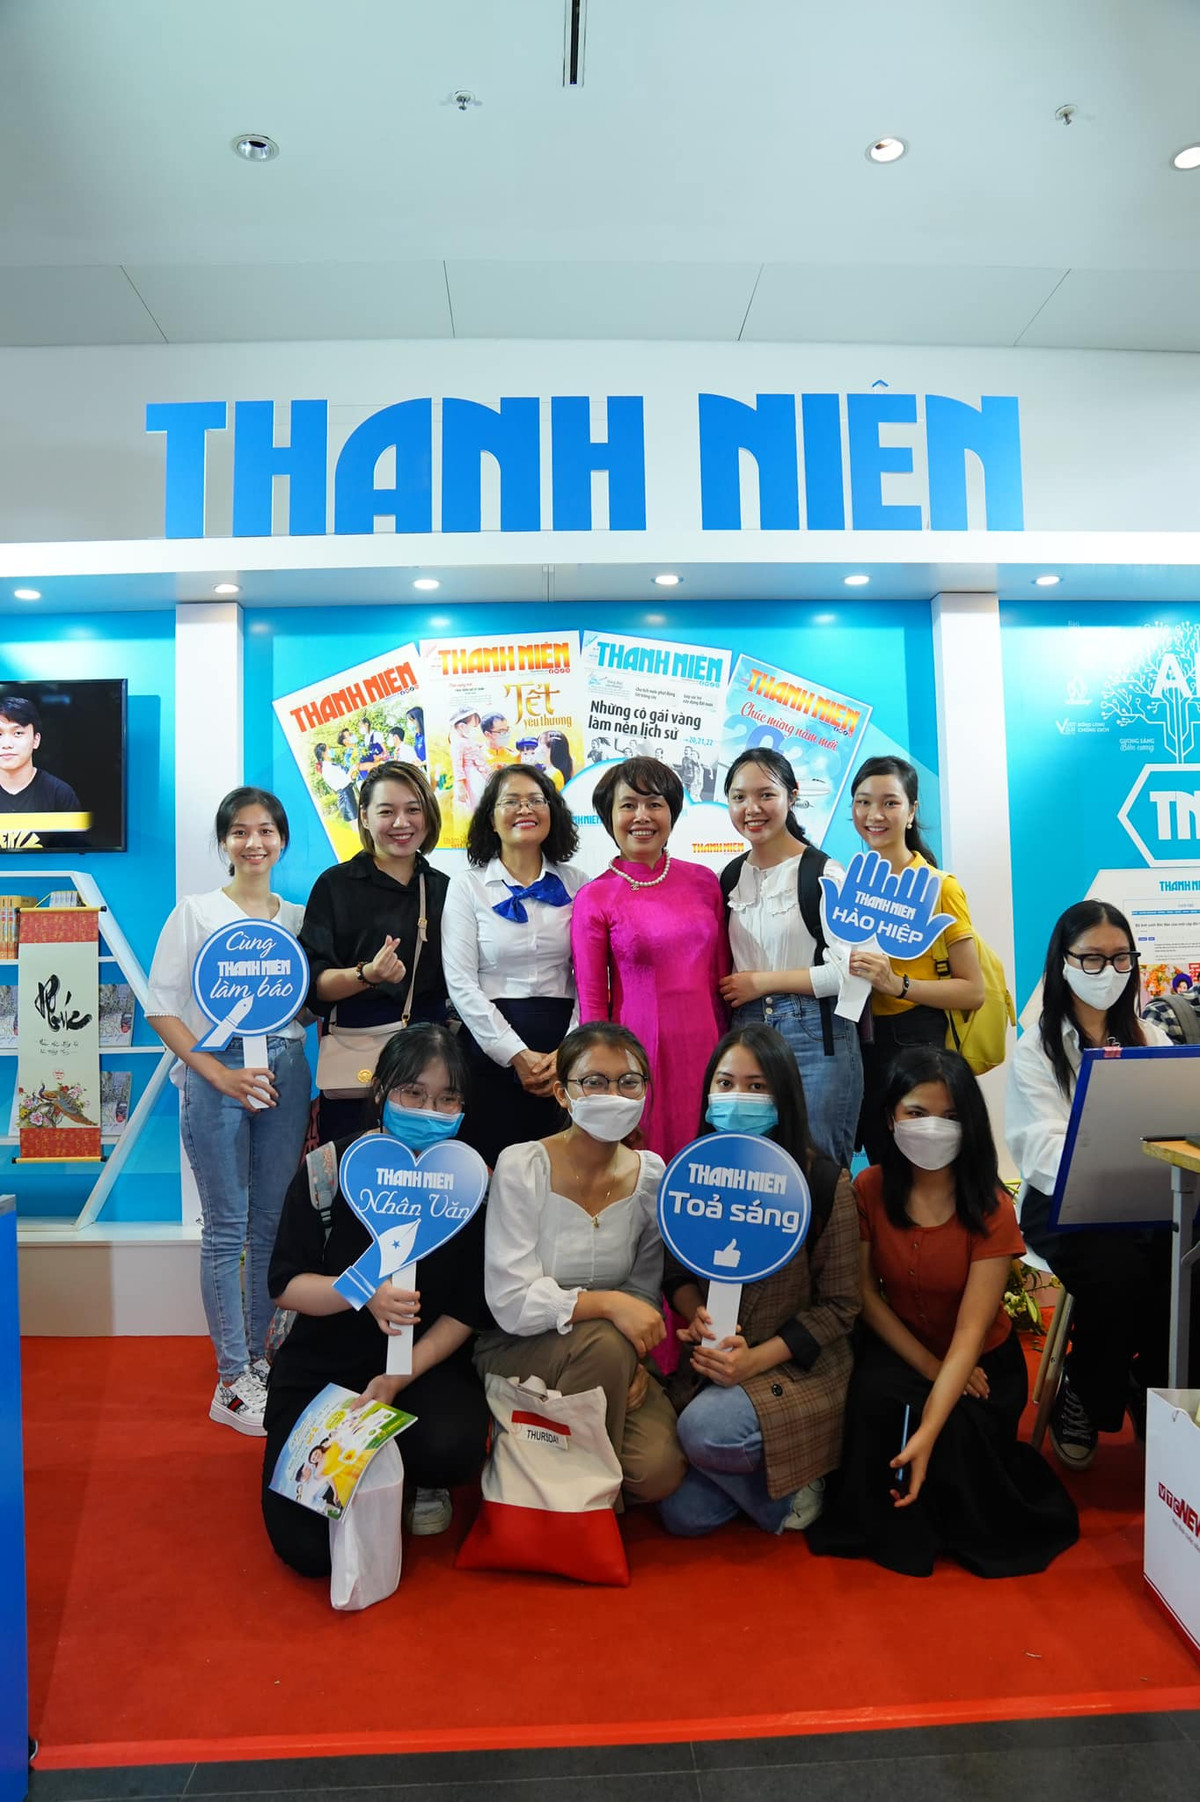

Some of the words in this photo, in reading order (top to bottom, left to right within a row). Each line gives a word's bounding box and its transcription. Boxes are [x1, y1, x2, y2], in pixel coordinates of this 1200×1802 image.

[146, 396, 647, 540] THANH
[698, 379, 1025, 532] NIÊN
[438, 646, 515, 675] THANH
[597, 641, 671, 676] THANH
[747, 669, 815, 715] THANH
[289, 682, 368, 732] THANH
[590, 699, 631, 720] Những
[633, 707, 647, 720] cô
[649, 709, 669, 724] gái
[671, 711, 702, 730] vàng
[588, 715, 612, 732] làm
[614, 720, 638, 735] nên
[640, 722, 662, 740] lịch
[664, 726, 680, 741] sử
[740, 701, 767, 723] Chúc
[795, 728, 817, 743] năm
[691, 842, 722, 853] THANH
[1159, 880, 1191, 892] THANH
[854, 890, 892, 914] THANH
[832, 906, 875, 931] HÀO
[877, 920, 924, 944] HIỆP
[225, 930, 277, 959] Cùng
[217, 960, 260, 977] THANH
[210, 976, 252, 999] làm
[257, 976, 294, 998] báo
[376, 1167, 422, 1189] THANH
[688, 1162, 746, 1190] THANH
[357, 1188, 422, 1217] Nhân
[428, 1193, 471, 1219] Văn
[668, 1190, 723, 1219] Toả
[729, 1199, 800, 1234] sáng
